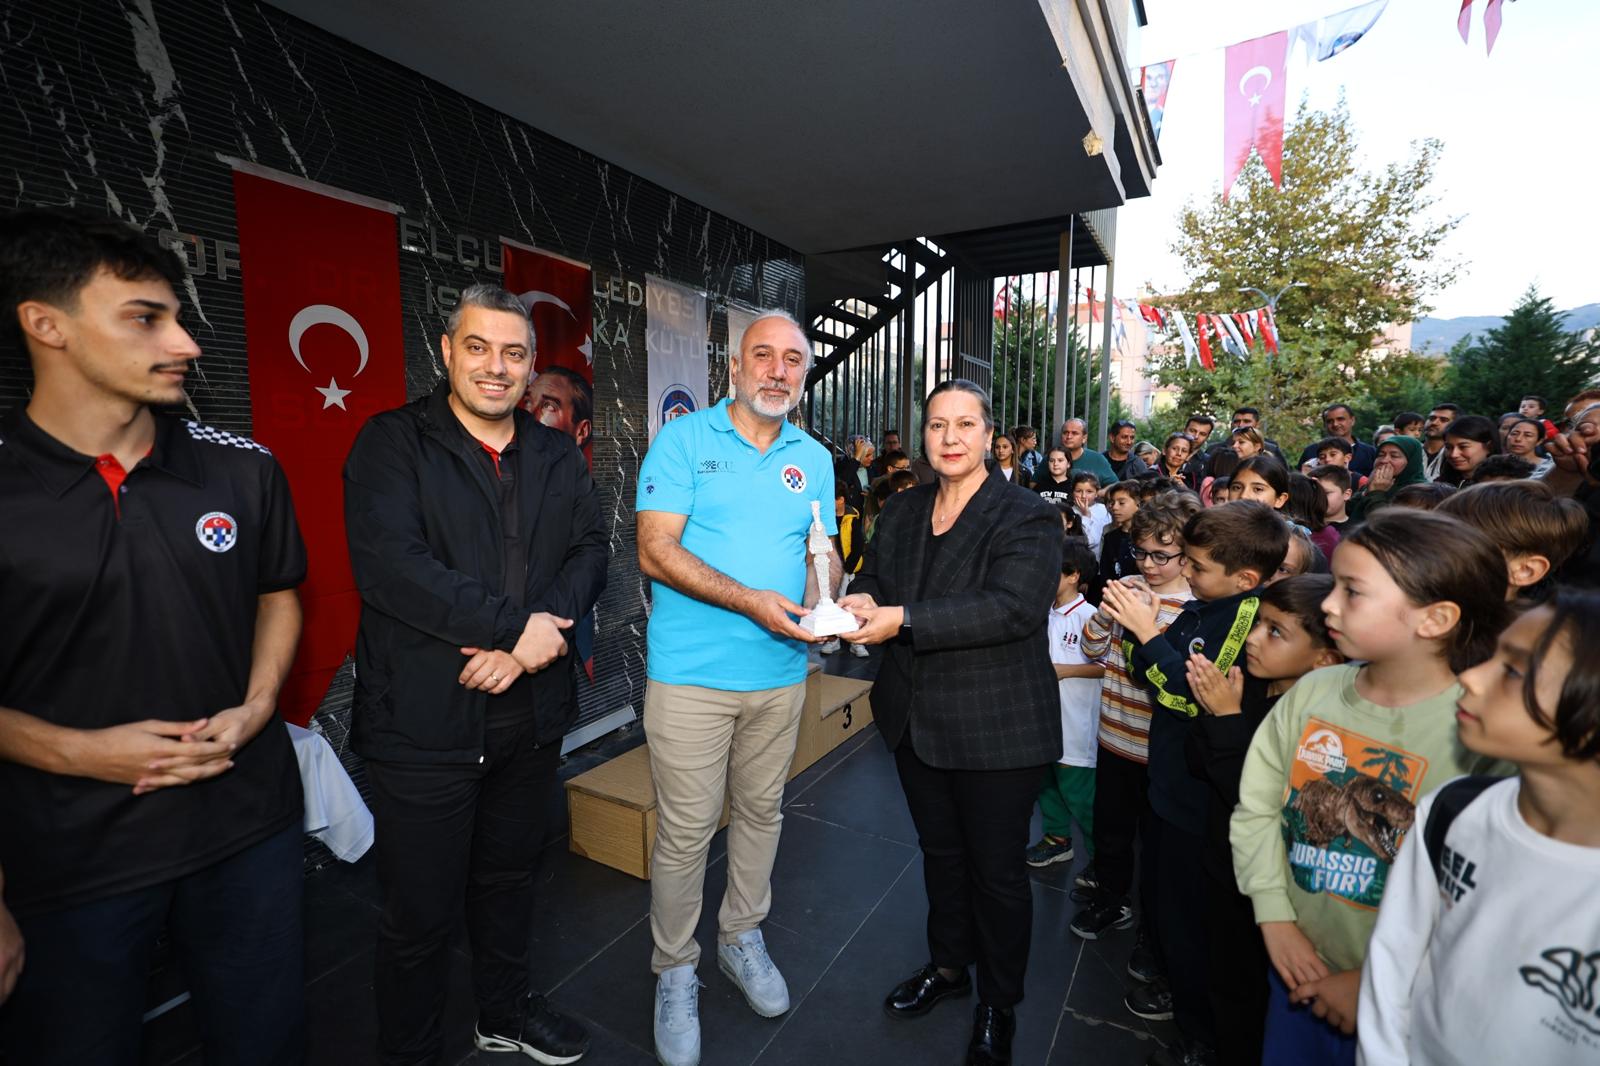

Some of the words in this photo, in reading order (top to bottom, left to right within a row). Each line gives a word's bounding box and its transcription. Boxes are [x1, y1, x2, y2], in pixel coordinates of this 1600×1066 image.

[843, 703, 852, 729] 3
[1291, 842, 1378, 874] JURASSIC
[1313, 869, 1375, 893] FURY
